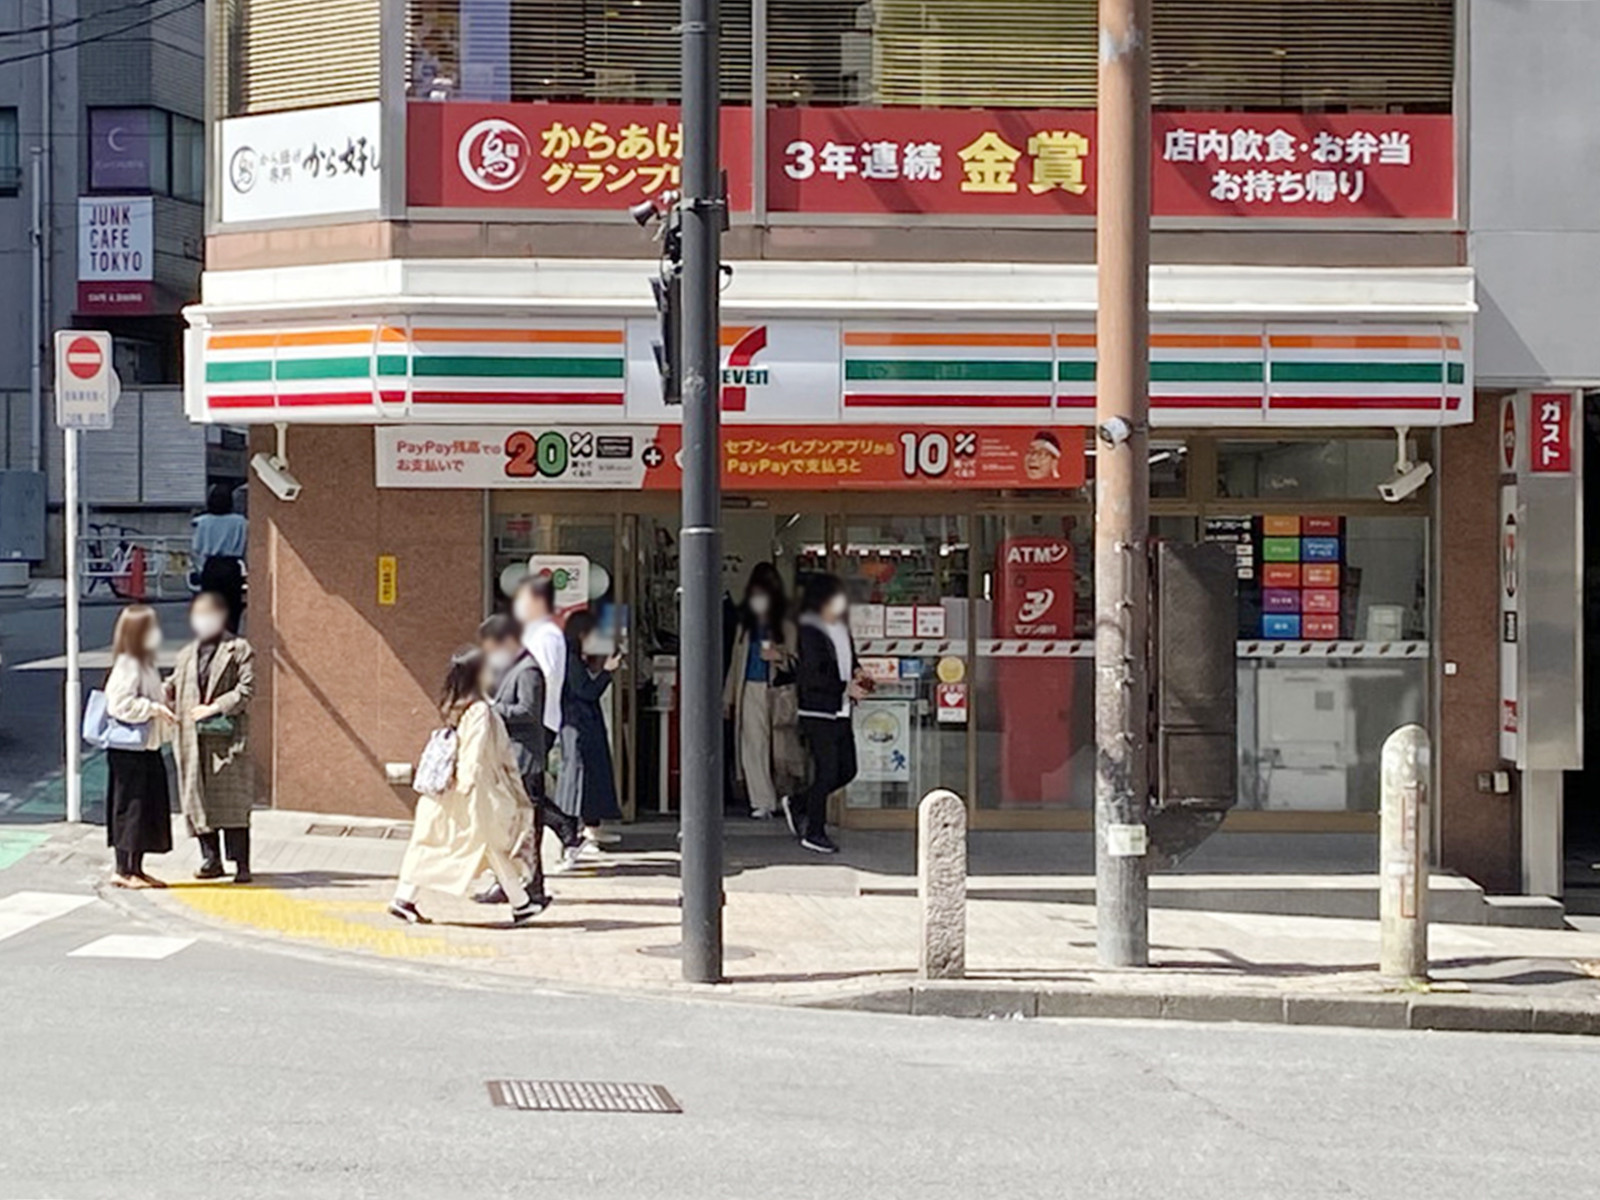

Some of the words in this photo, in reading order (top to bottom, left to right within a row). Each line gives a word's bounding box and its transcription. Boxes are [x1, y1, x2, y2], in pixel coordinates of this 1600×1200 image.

[1162, 128, 1412, 165] 店内飲食・お弁当
[784, 141, 942, 181] 3年連続
[957, 130, 1089, 195] 金賞
[1210, 169, 1365, 203] お持ち帰り
[89, 204, 131, 226] JUNK
[90, 228, 130, 249] CAFE
[90, 251, 142, 272] TOKYO
[1540, 401, 1561, 466] ガスト
[1008, 546, 1051, 563] ATM
